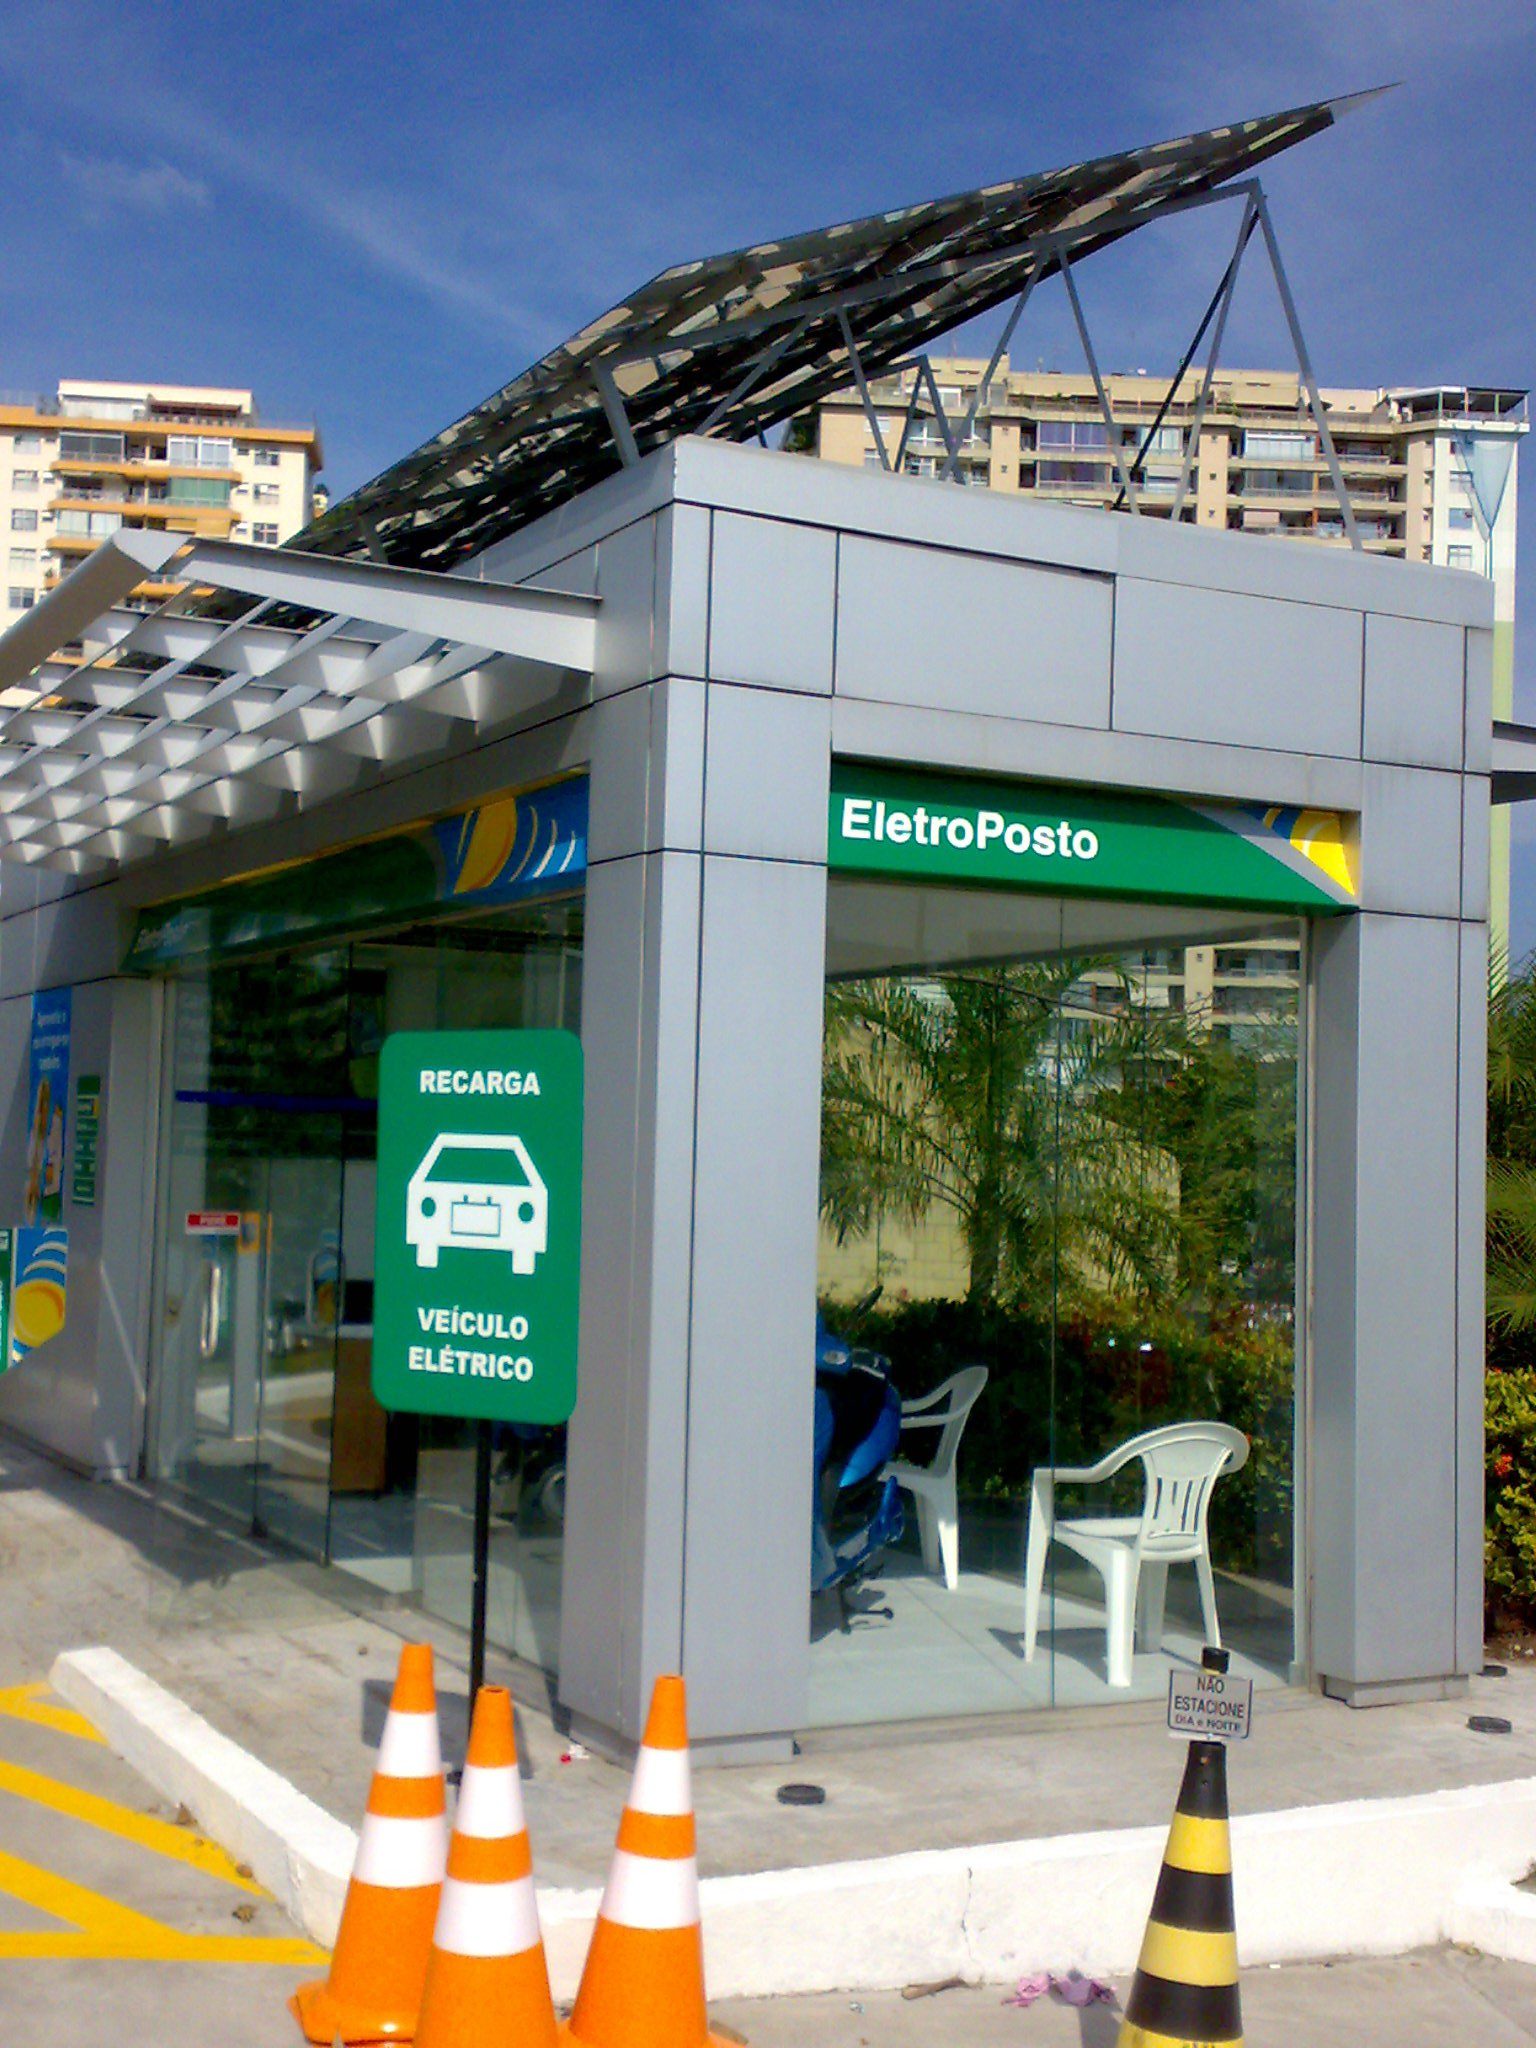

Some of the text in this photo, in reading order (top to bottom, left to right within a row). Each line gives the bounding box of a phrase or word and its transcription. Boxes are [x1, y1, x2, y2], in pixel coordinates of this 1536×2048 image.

[841, 798, 1099, 861] EletroPosto
[419, 1069, 541, 1096] RECARGA
[417, 1305, 529, 1341] VEÍCULO
[408, 1344, 534, 1382] ELÉTRICO
[1197, 1676, 1225, 1694] NÃO
[1174, 1695, 1245, 1719] ESTACIONE
